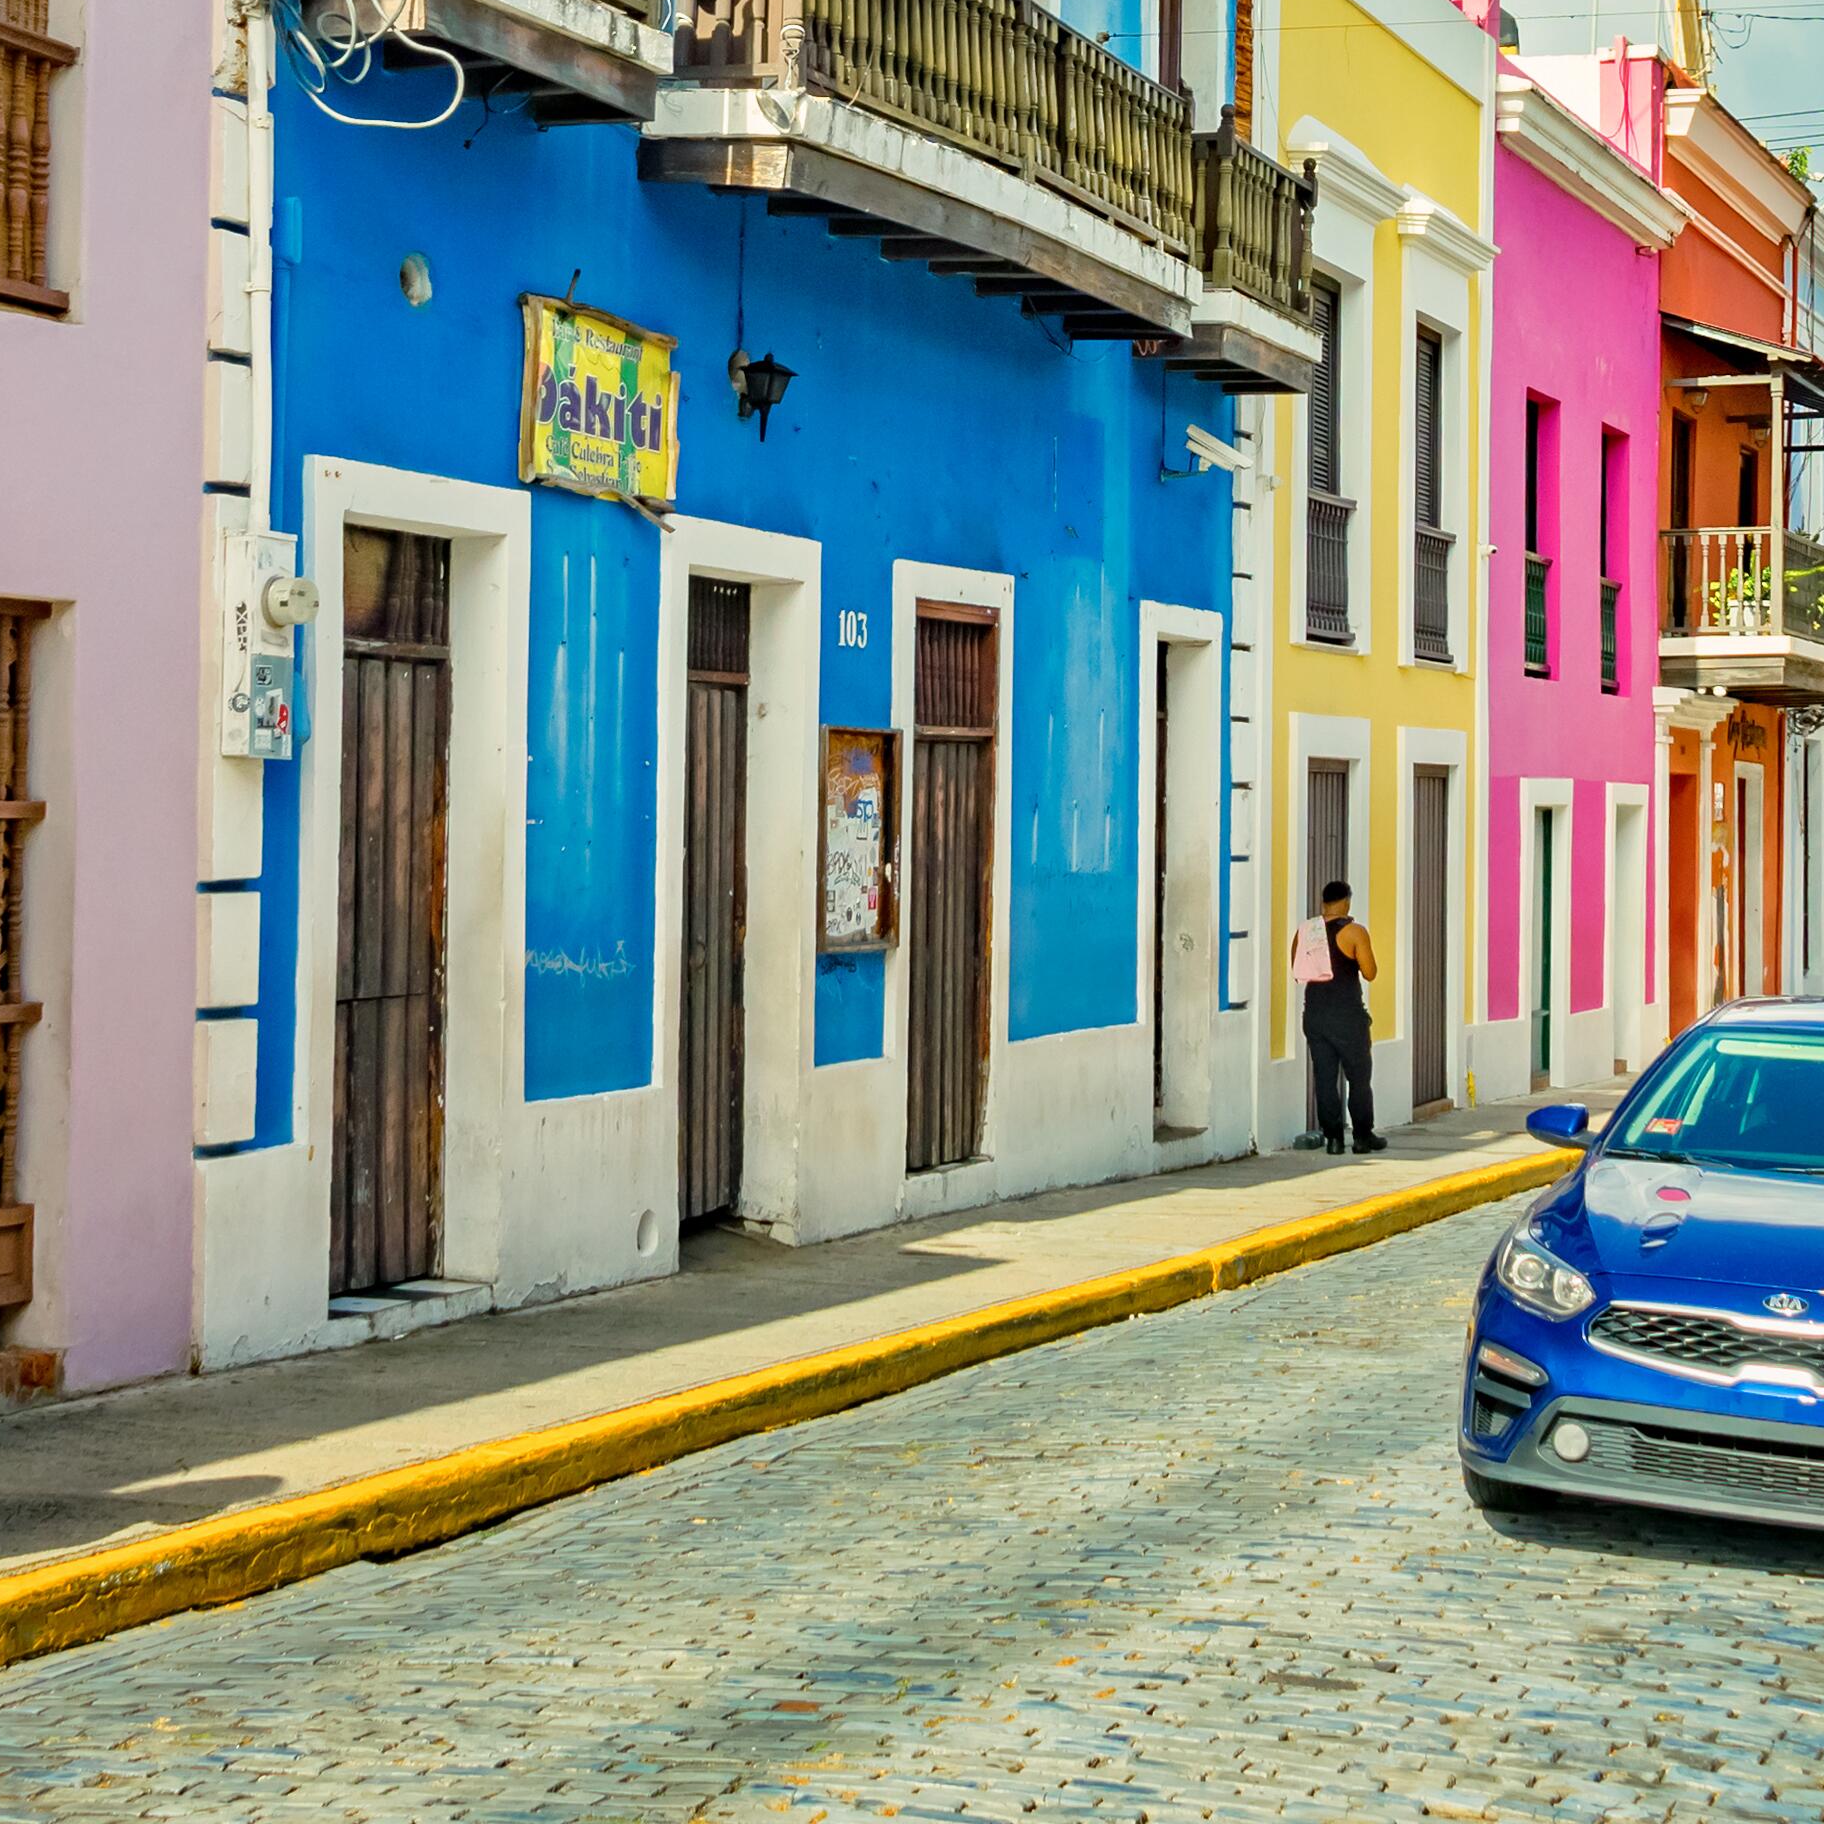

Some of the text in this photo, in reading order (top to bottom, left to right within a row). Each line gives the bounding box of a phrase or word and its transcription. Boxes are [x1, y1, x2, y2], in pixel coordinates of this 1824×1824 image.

[585, 328, 644, 362] Restaurant
[571, 441, 614, 467] Culebra
[838, 609, 868, 649] 103
[1769, 1295, 1803, 1311] KIA
